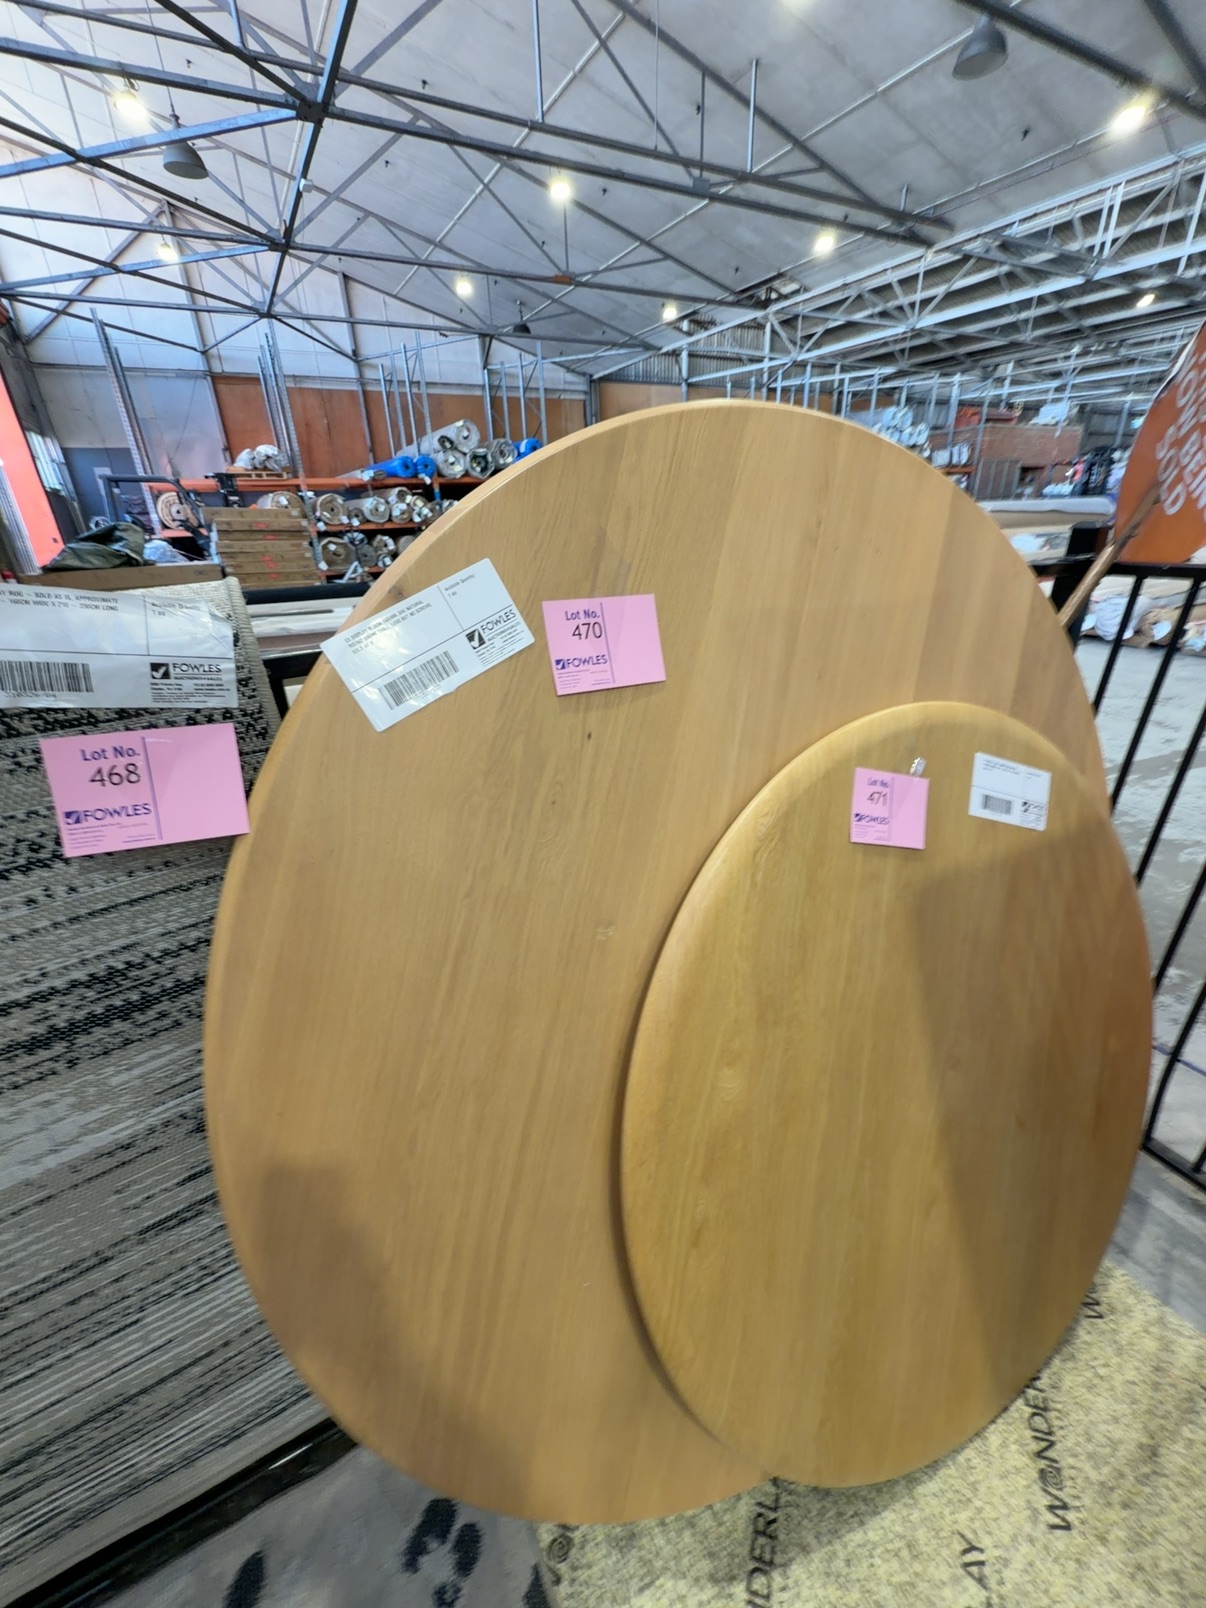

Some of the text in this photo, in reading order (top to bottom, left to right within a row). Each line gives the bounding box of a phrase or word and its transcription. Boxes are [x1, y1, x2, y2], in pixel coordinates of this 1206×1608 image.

[1156, 424, 1187, 516] SOLD
[479, 608, 516, 634] FOWLES
[565, 609, 600, 620] Lot No.
[572, 621, 603, 640] 470
[172, 663, 222, 673] FOWLES
[567, 654, 608, 668] FOWLES
[81, 746, 140, 762] Lot No.
[89, 763, 141, 787] 468
[867, 791, 888, 807] 471
[84, 803, 152, 822] FOWLES
